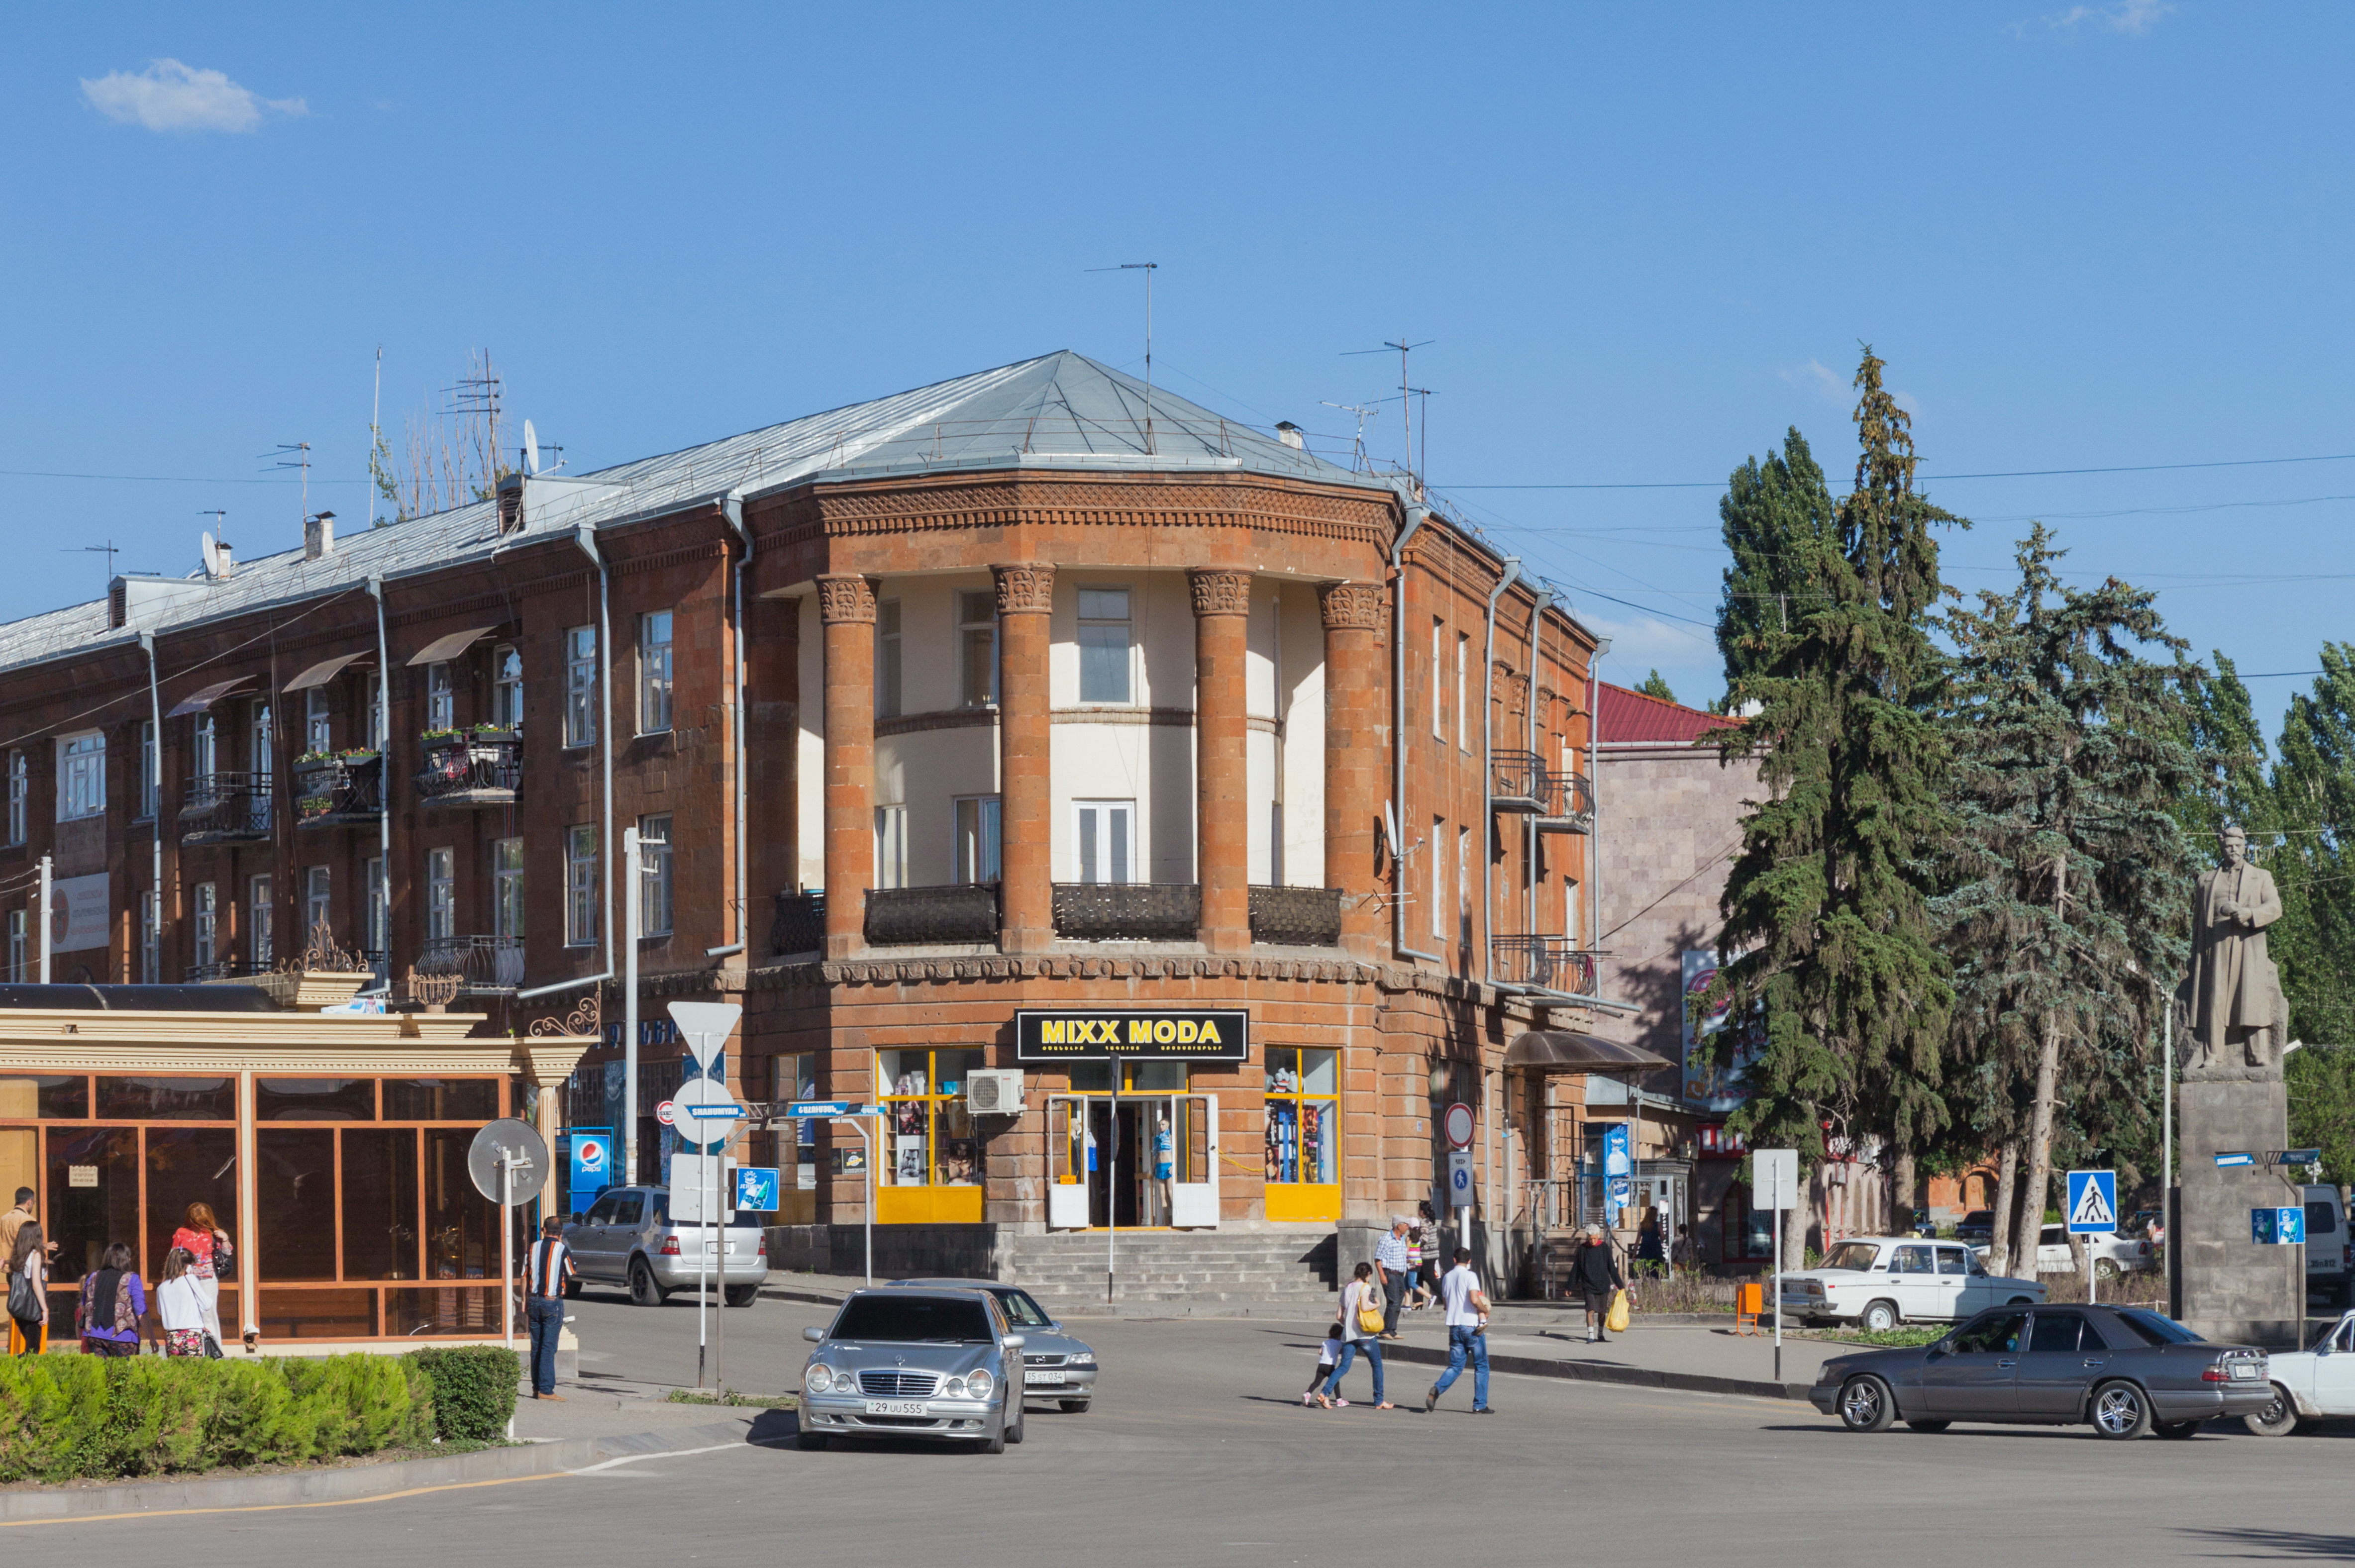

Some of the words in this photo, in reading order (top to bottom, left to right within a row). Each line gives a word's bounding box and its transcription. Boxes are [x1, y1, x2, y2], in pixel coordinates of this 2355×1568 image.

[1042, 1020, 1121, 1044] MIXX
[1129, 1020, 1222, 1044] MODA
[692, 1107, 738, 1116] SHAHUMYAN
[798, 1105, 836, 1114] ՇԱՀՈՒՄՅԱՆ
[2217, 1156, 2248, 1165] SHAHUMYAN
[876, 1402, 887, 1412] 29
[903, 1404, 922, 1413] 555
